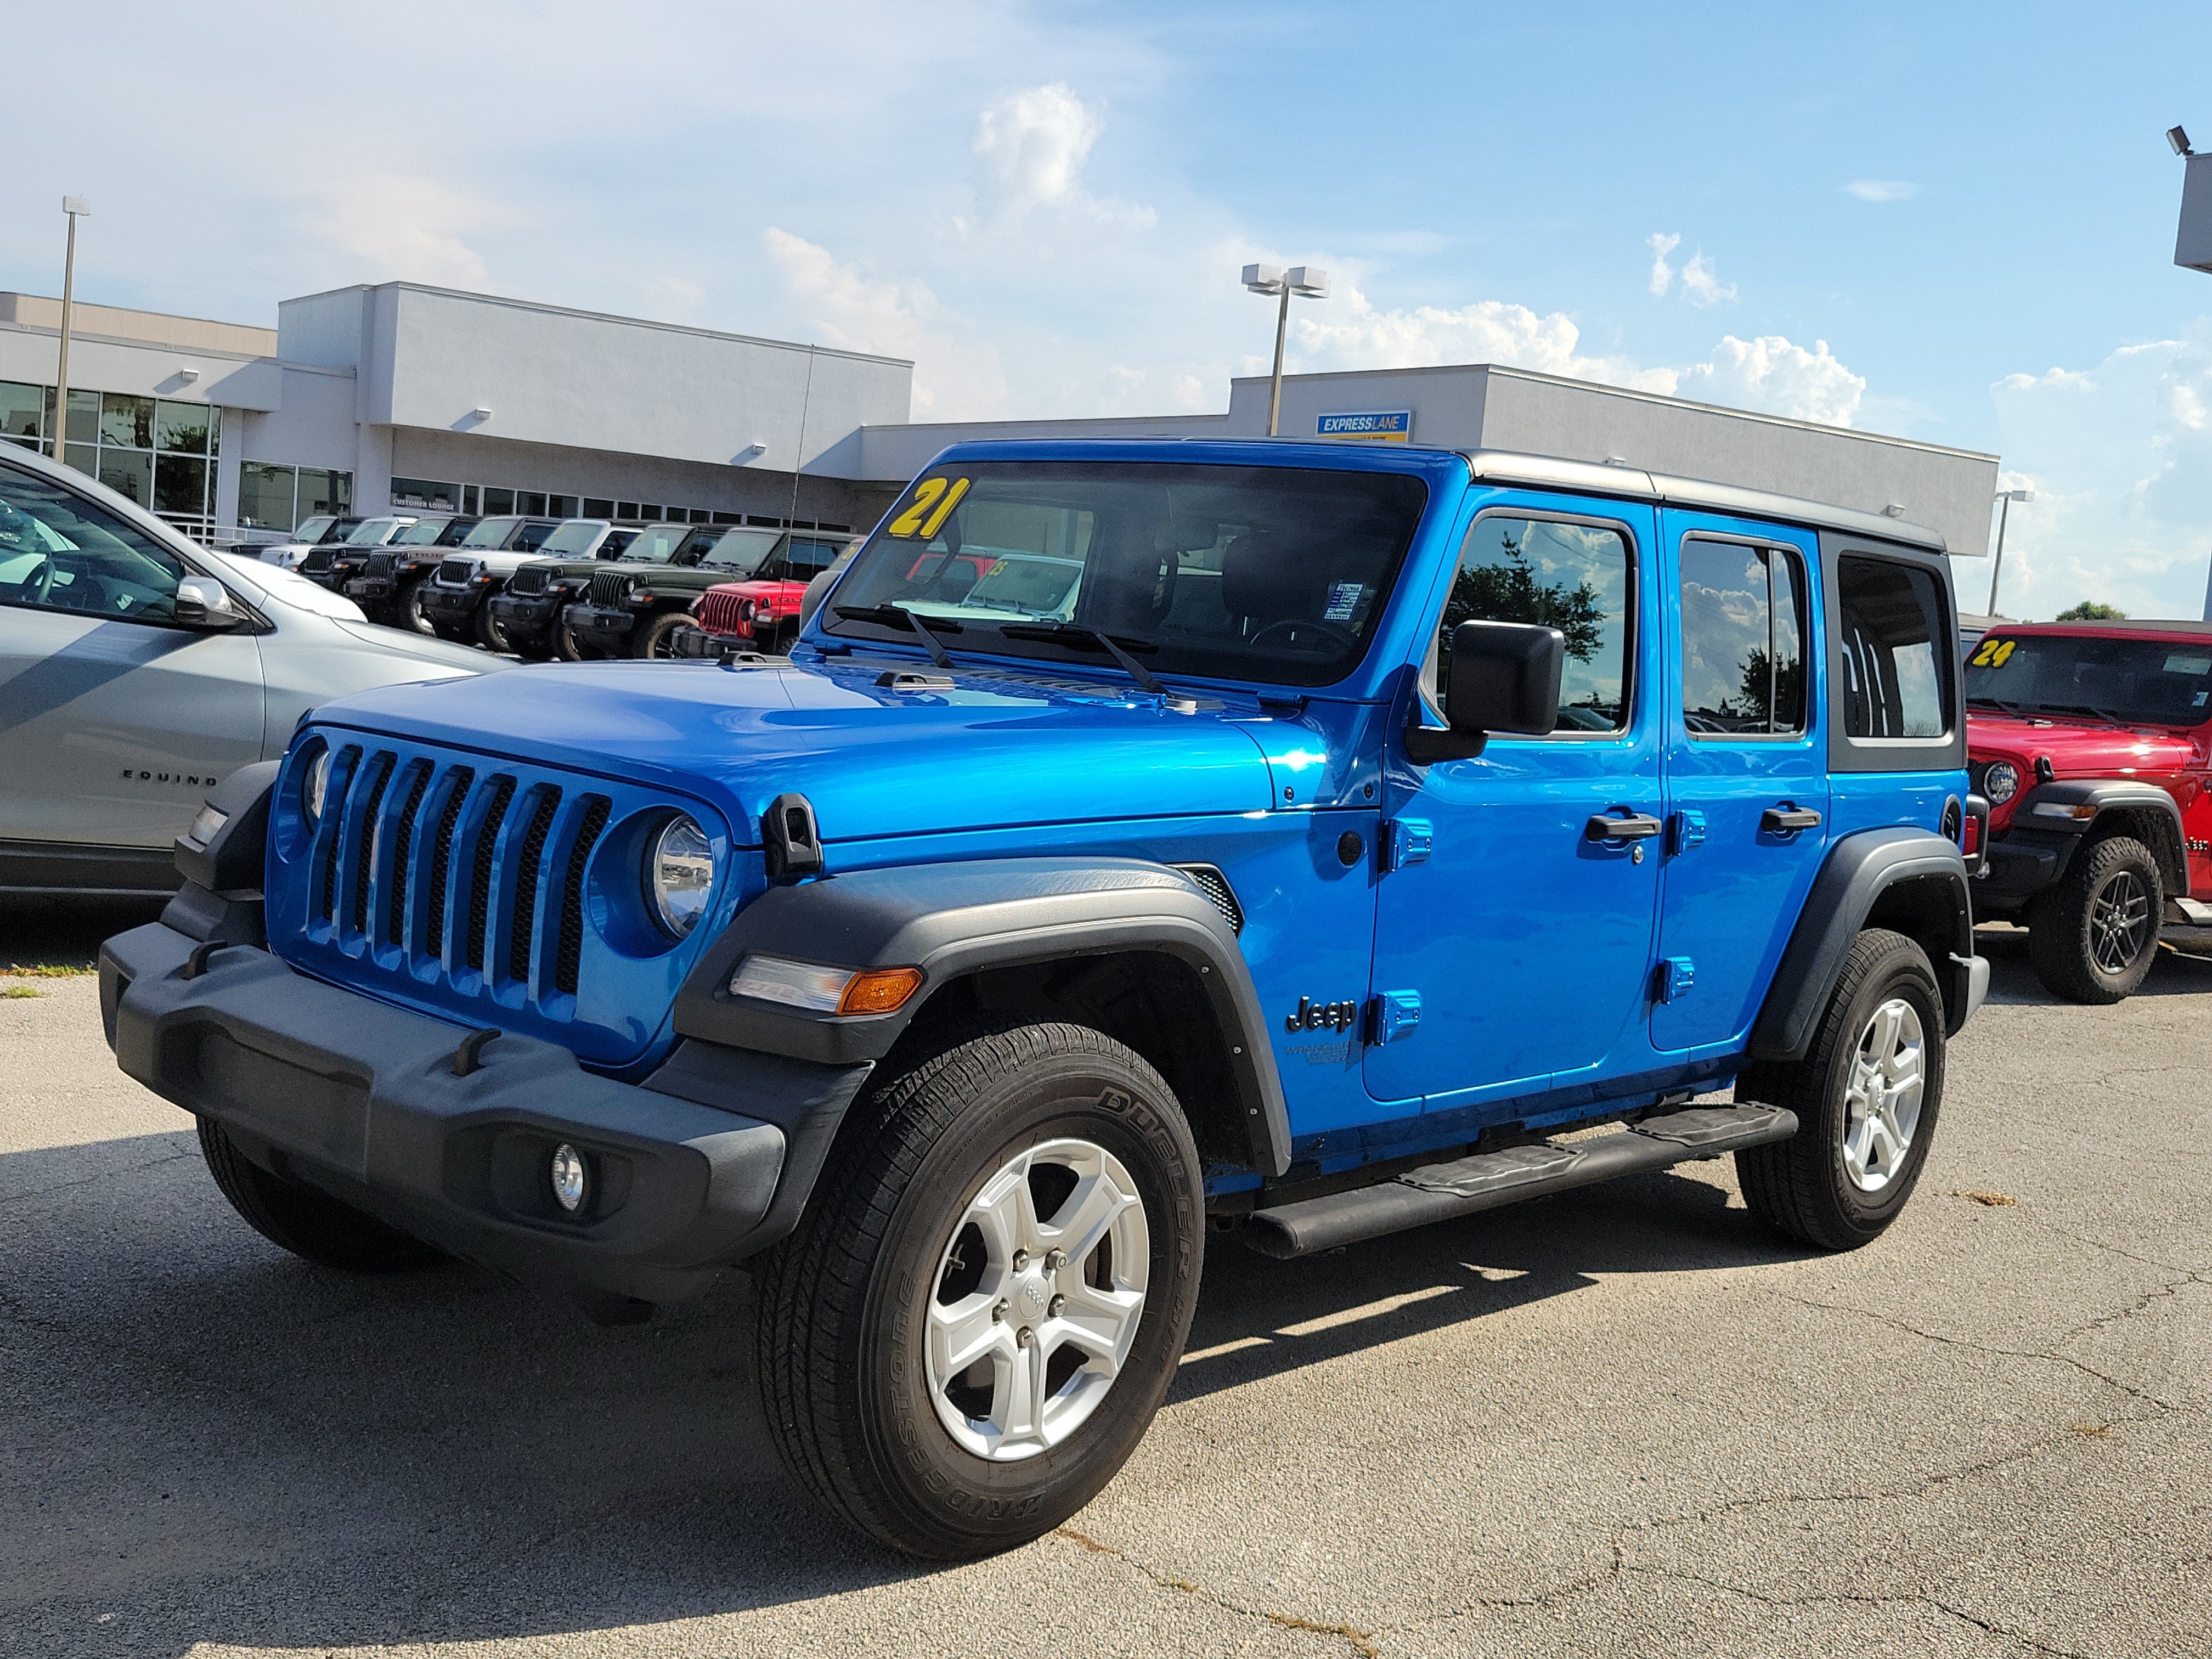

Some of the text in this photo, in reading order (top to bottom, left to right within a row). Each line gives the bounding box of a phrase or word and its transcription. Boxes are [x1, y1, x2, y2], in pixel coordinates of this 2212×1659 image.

[1324, 416, 1400, 432] EXPRESSLANE
[393, 499, 454, 511] CUSTOMER LOUNGE
[889, 478, 971, 539] 21
[988, 561, 1008, 577] 25
[1972, 640, 2016, 668] 24
[123, 770, 217, 786] EQUINO
[1286, 996, 1357, 1033] Jeep
[1095, 1086, 1193, 1280] DUELER
[890, 1272, 1047, 1520] BRIDGESTONE
